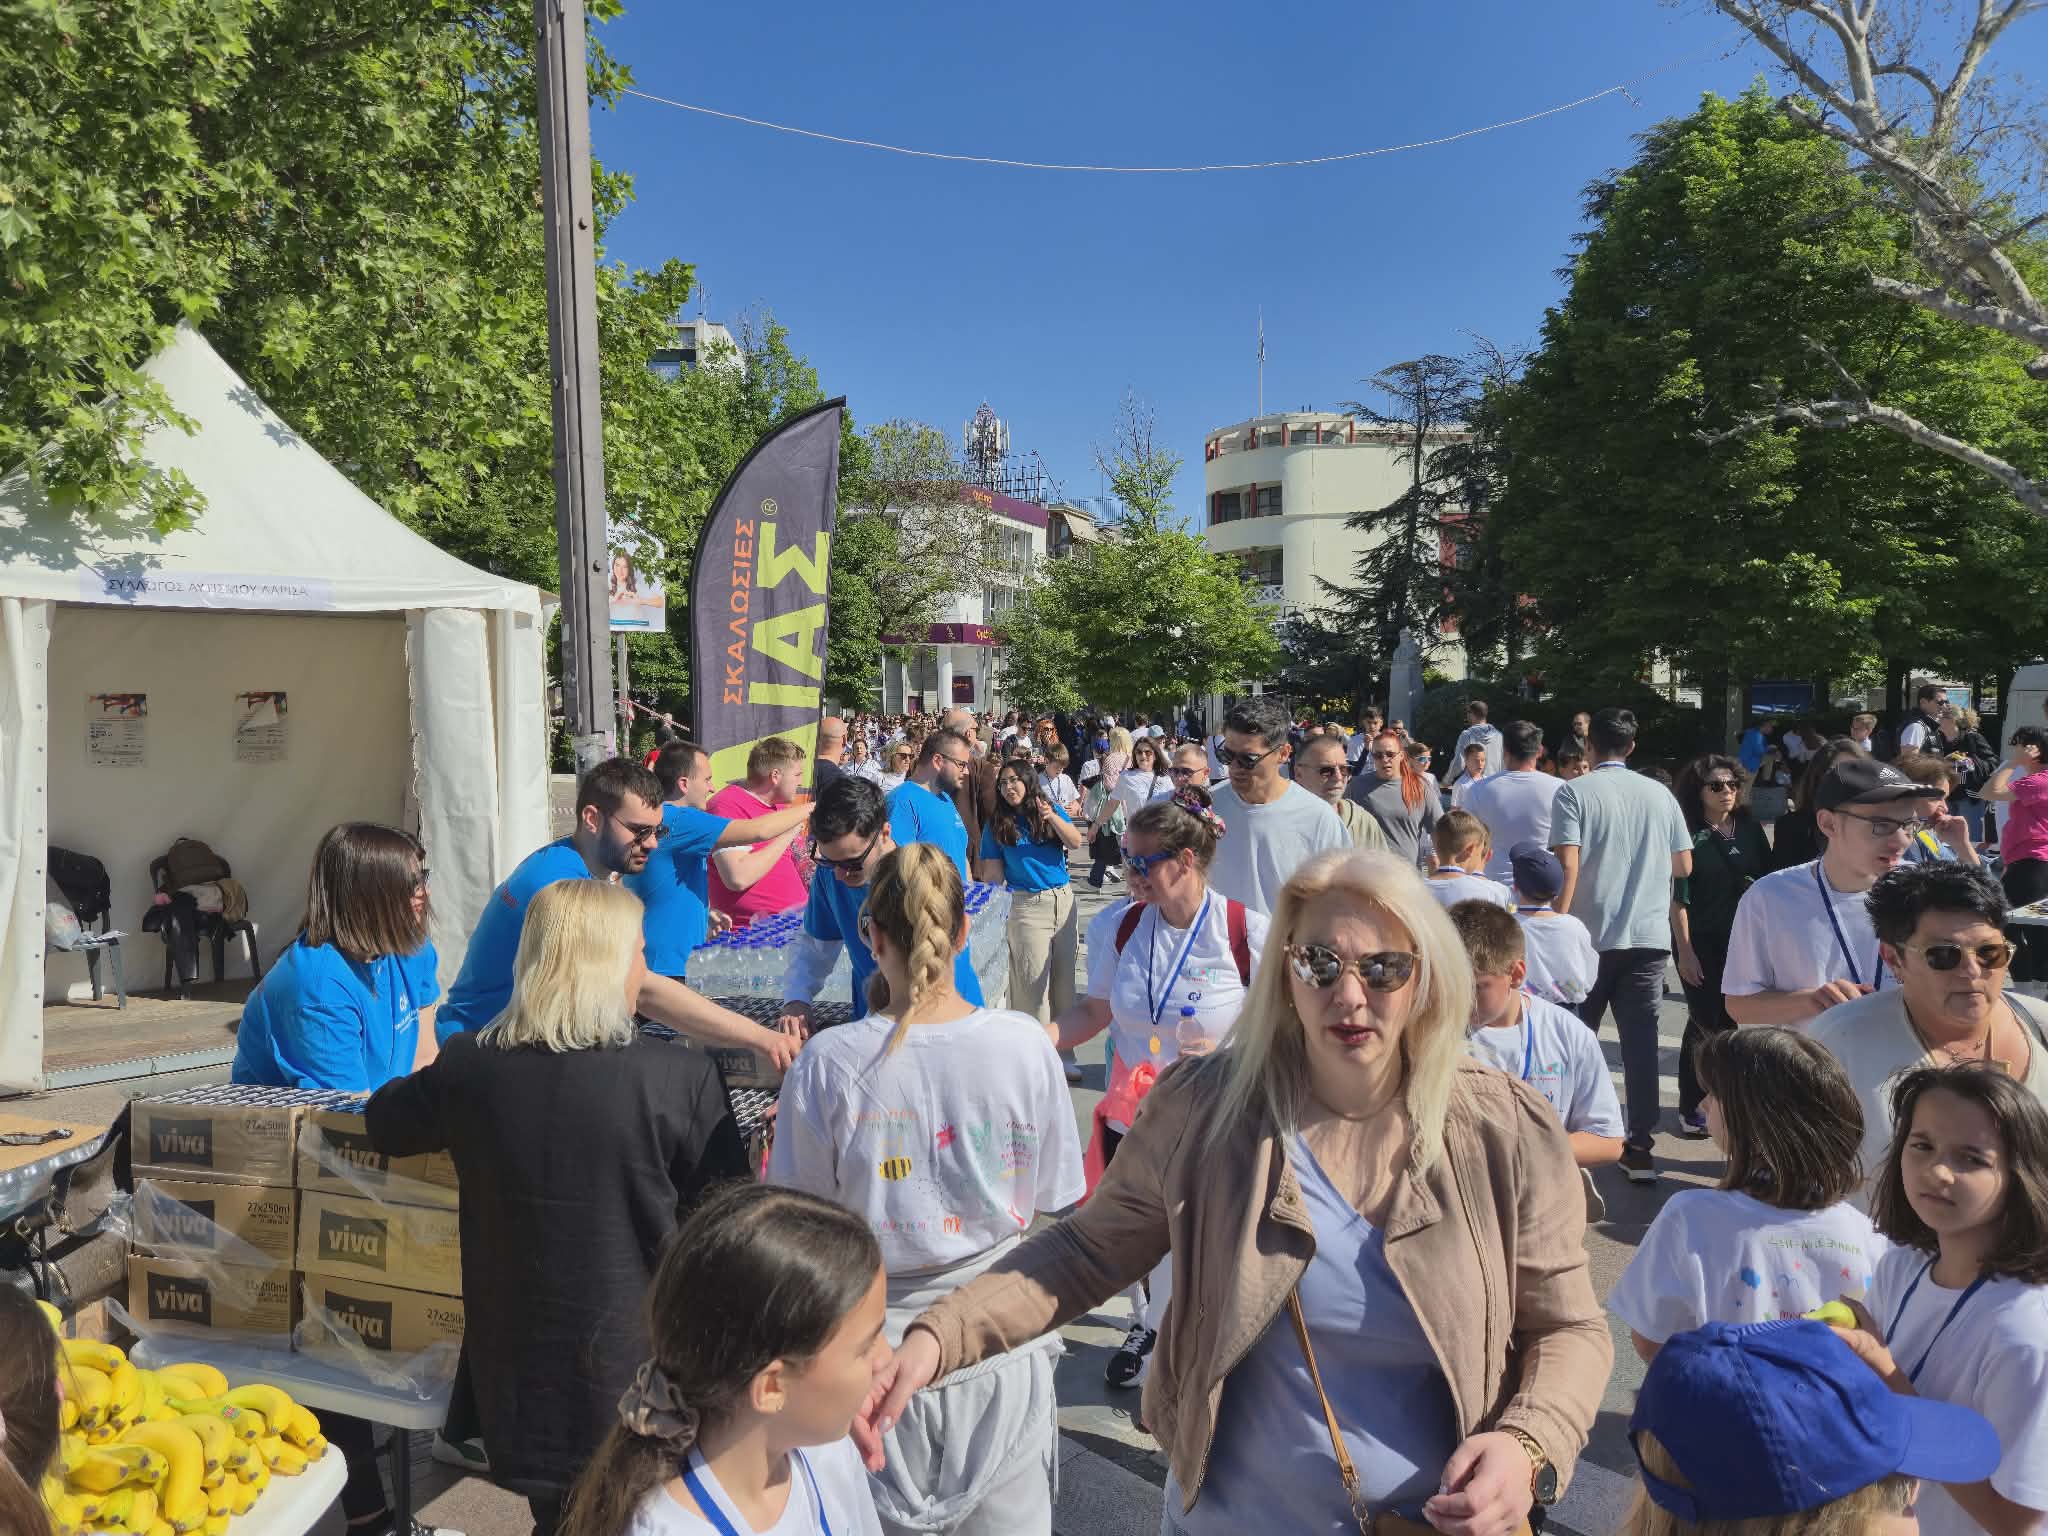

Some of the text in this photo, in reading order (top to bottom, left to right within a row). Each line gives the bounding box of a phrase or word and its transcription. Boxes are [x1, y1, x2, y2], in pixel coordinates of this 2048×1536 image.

[723, 519, 754, 705] ΣΚΑΛΩΣΙΕΣ
[157, 1128, 207, 1156] viva
[247, 1202, 291, 1214] 27x250ml
[328, 1224, 379, 1257] viva
[155, 1284, 204, 1313] viva
